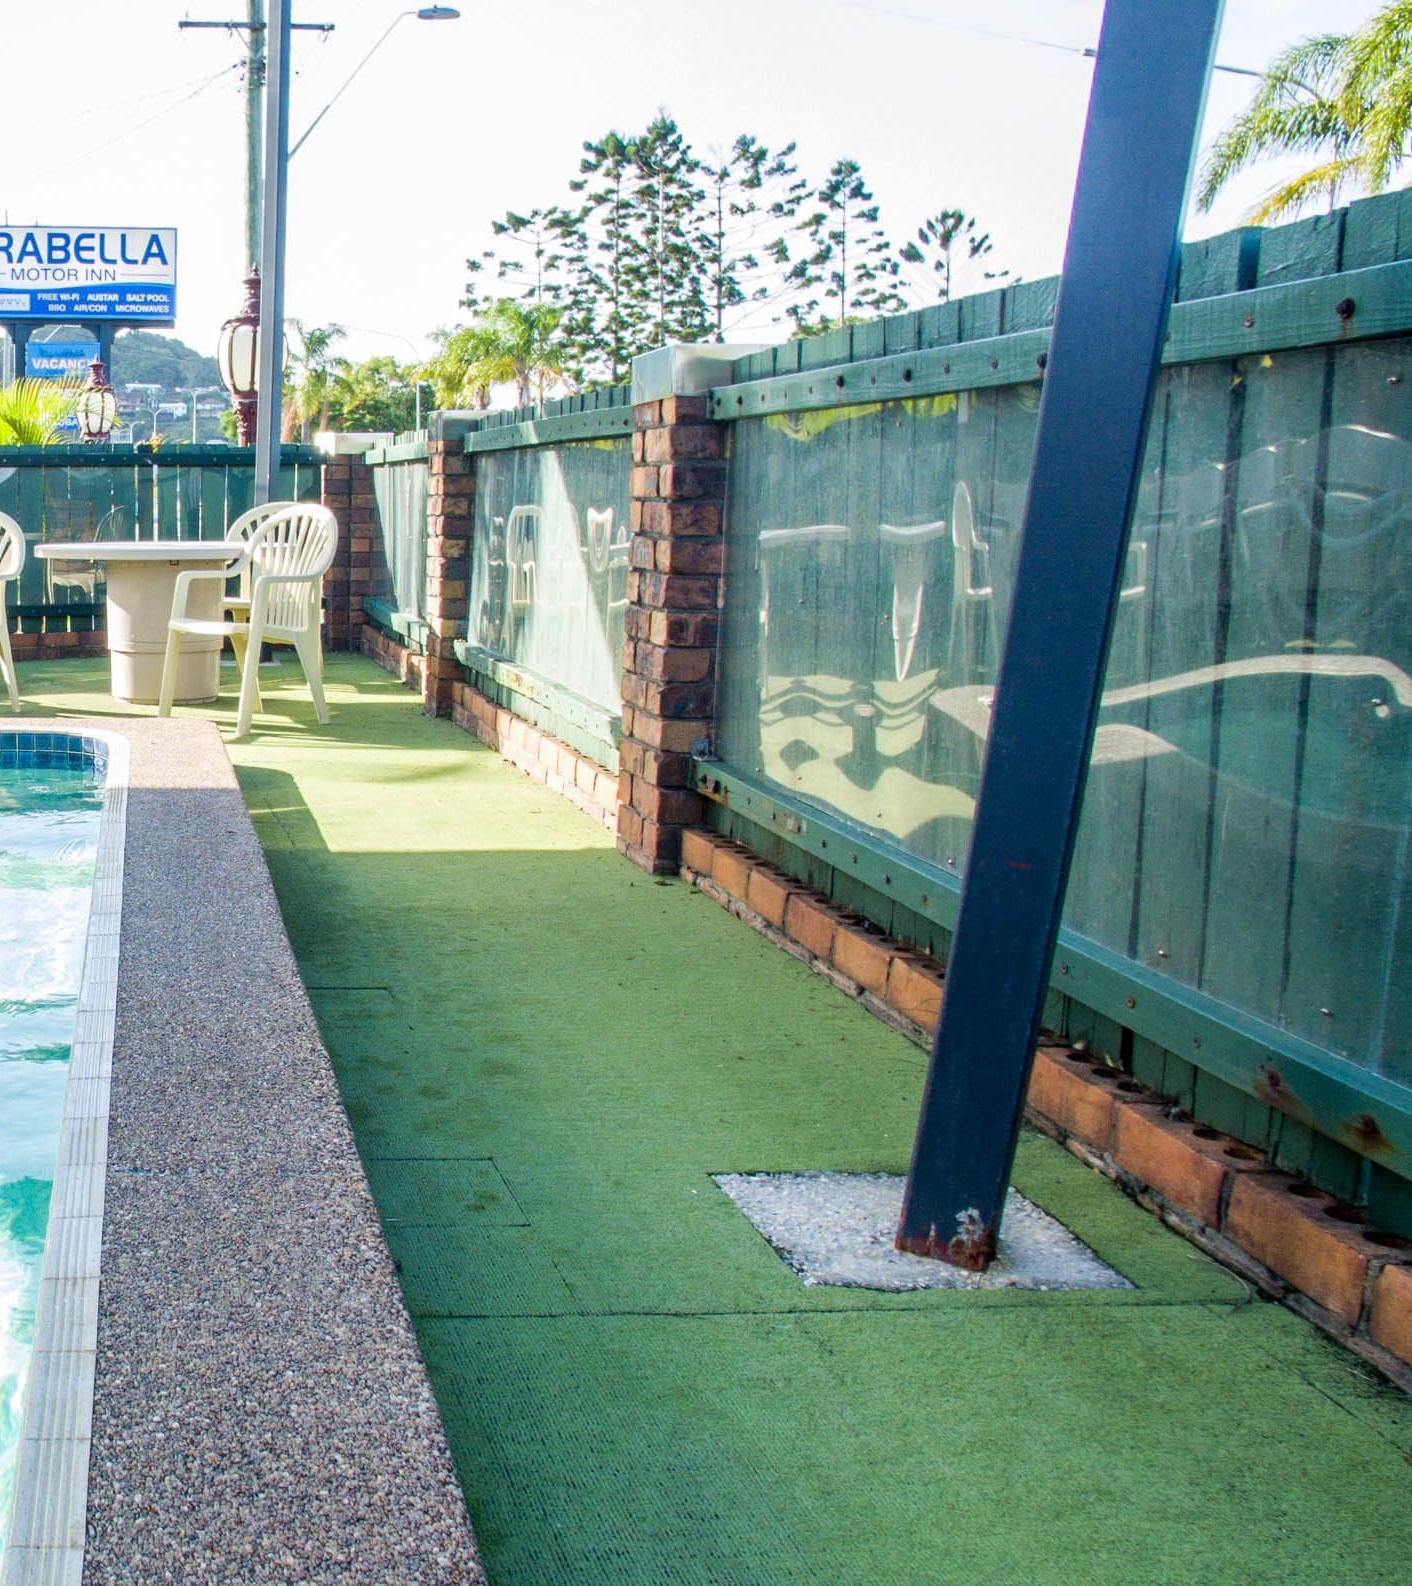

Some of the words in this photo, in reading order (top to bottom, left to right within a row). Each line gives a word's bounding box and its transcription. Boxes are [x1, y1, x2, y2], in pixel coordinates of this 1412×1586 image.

[10, 267, 79, 282] MOTOR
[85, 268, 117, 282] INN
[37, 293, 58, 302] FREE
[87, 293, 119, 302] AUSTAR
[126, 294, 146, 302] SALT
[147, 294, 169, 302] POOL
[48, 304, 66, 312] BBQ
[115, 304, 169, 313] MICROWAVES
